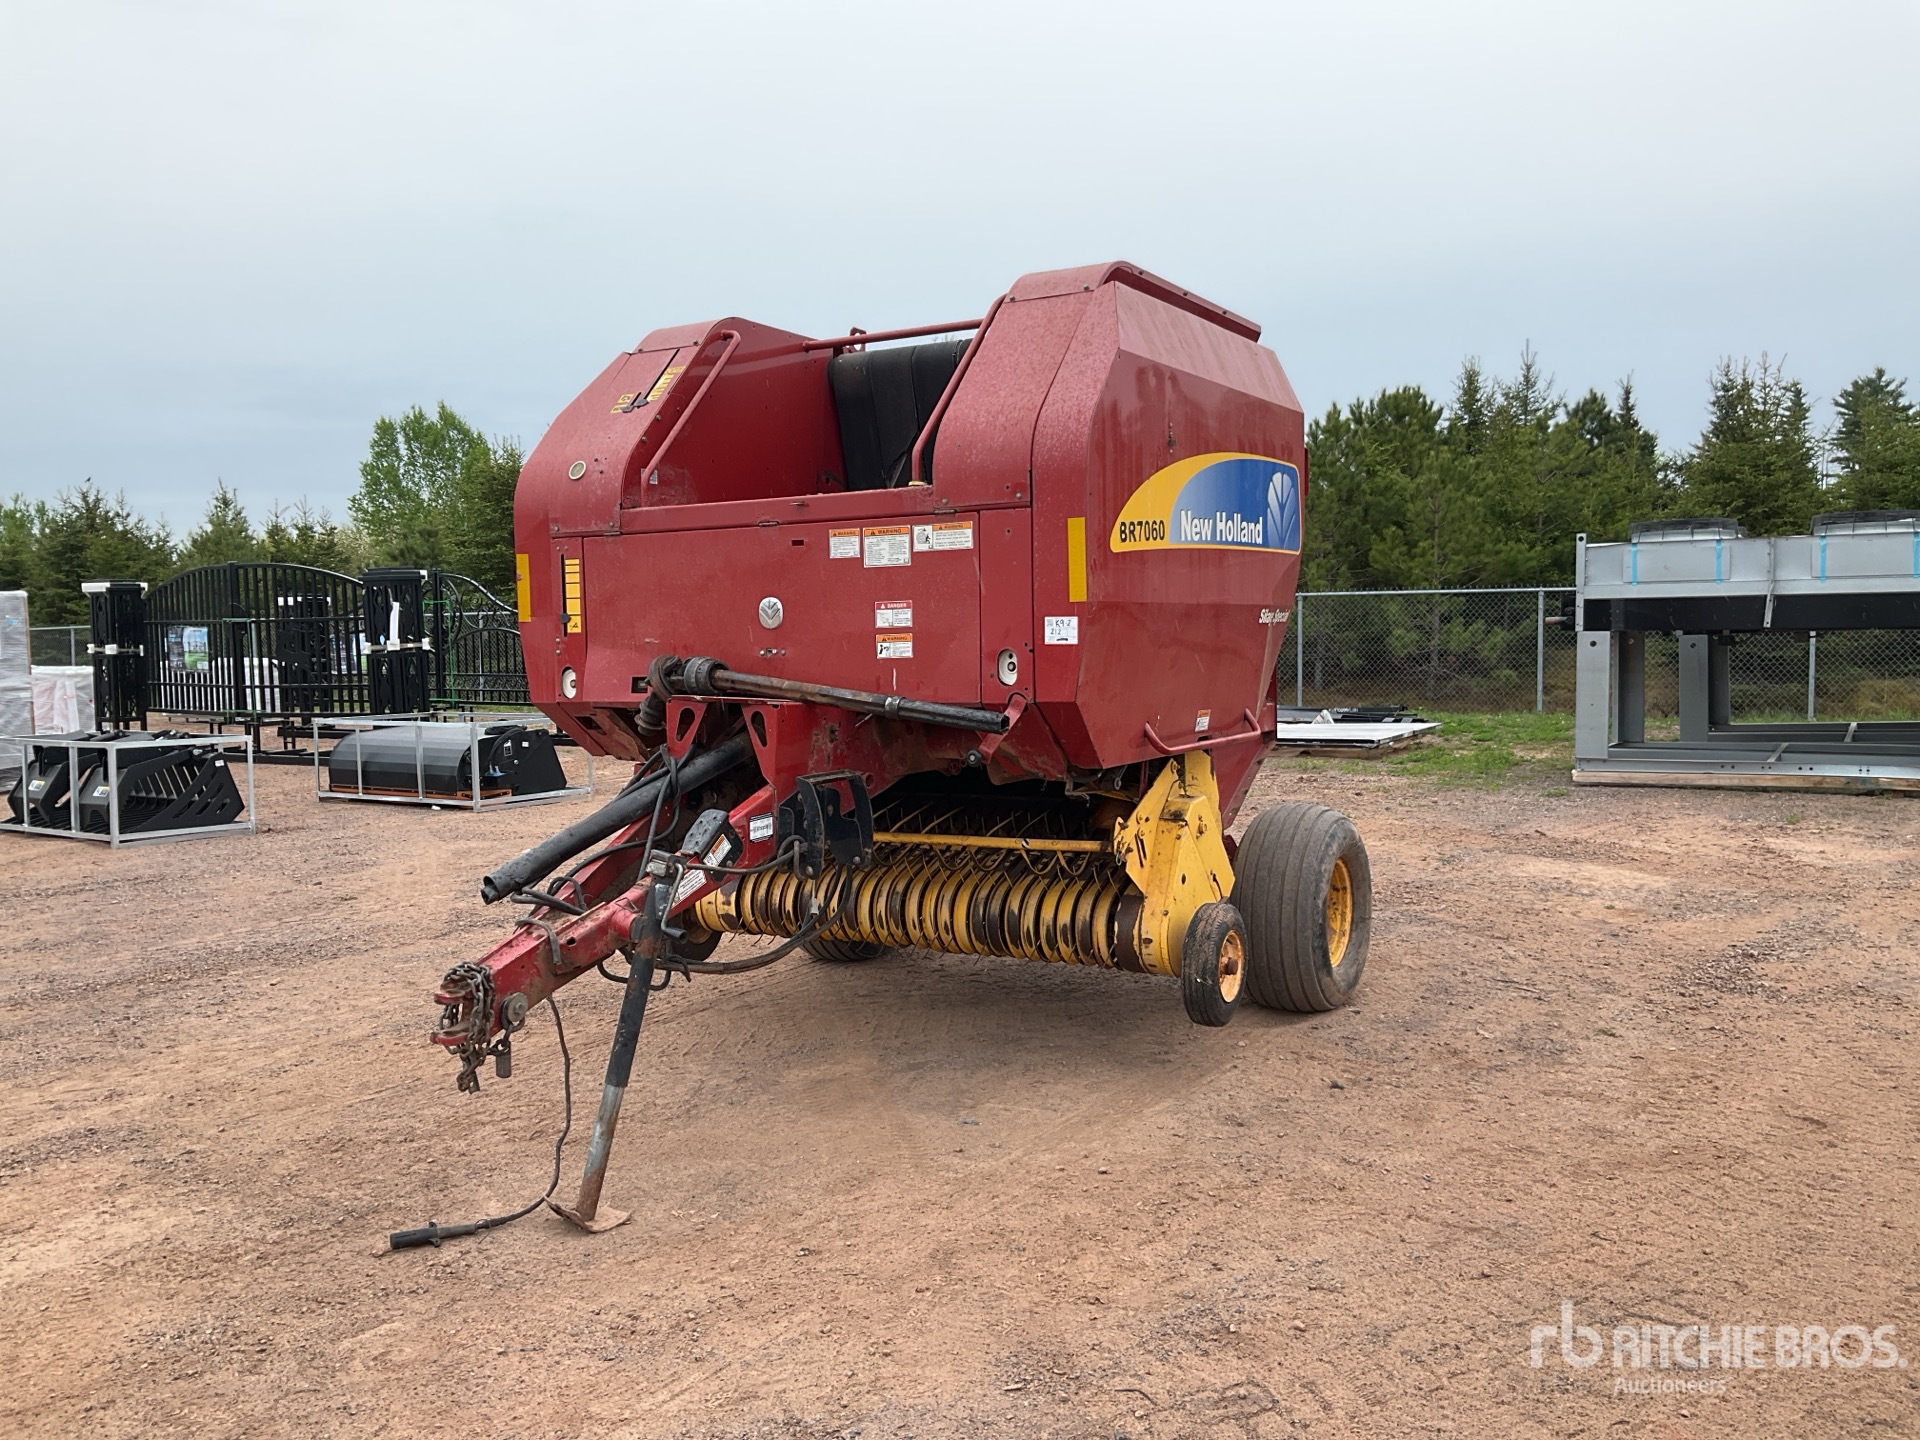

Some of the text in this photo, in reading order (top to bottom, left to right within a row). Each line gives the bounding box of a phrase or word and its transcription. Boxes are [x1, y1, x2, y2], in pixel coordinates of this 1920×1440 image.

[1119, 520, 1165, 543] BR7060
[1180, 509, 1263, 545] New Holland
